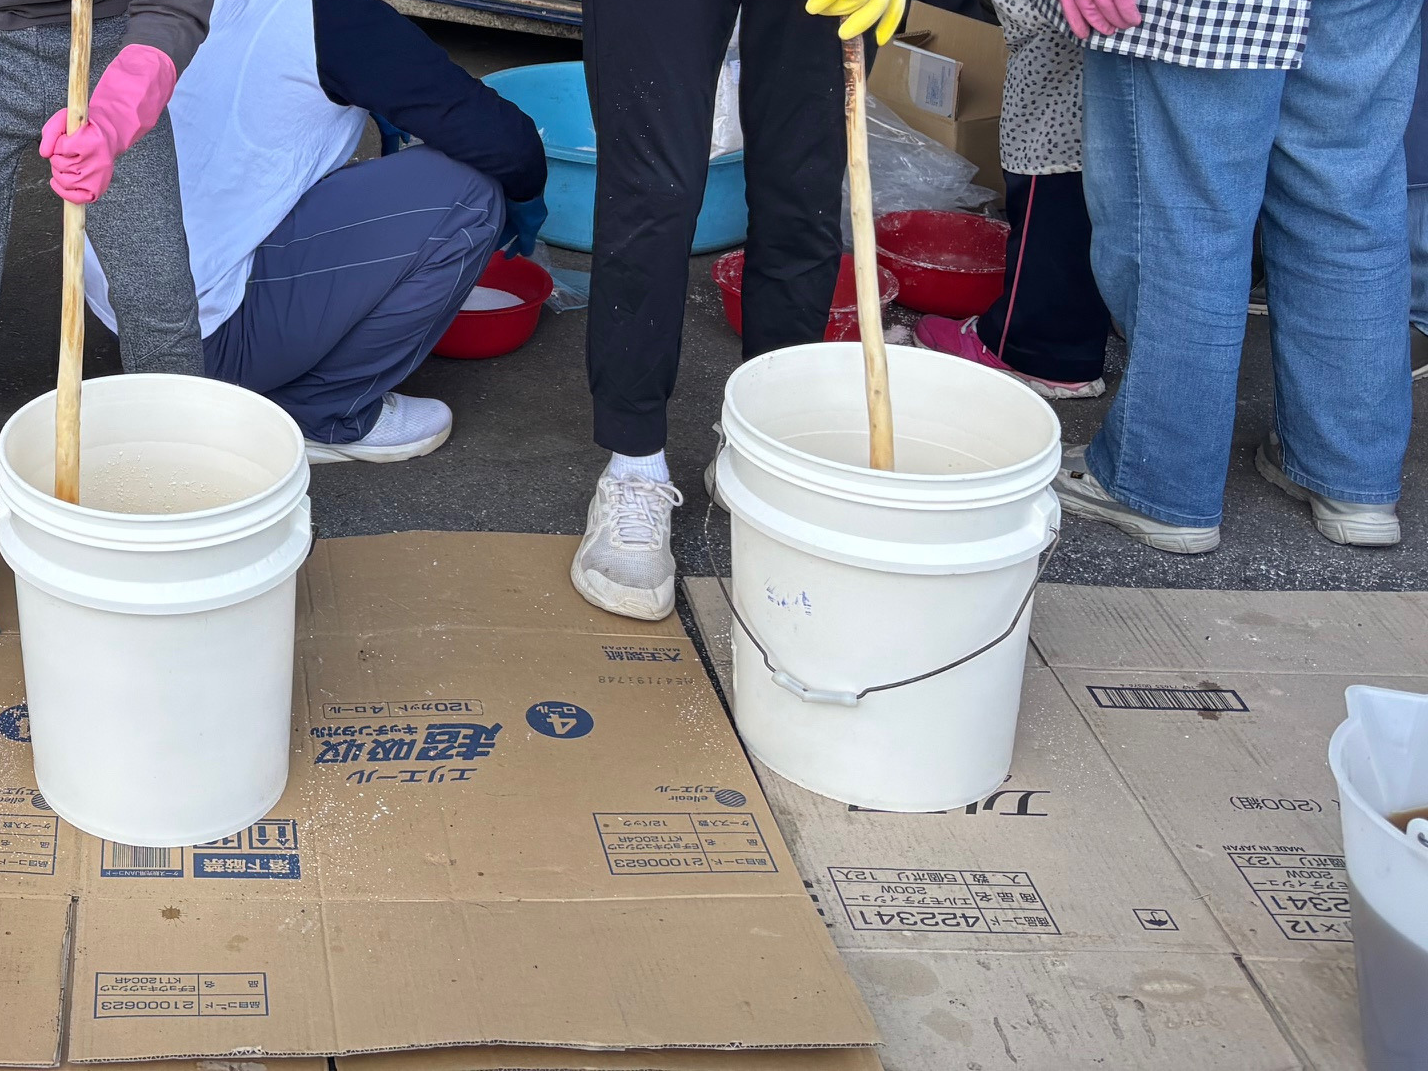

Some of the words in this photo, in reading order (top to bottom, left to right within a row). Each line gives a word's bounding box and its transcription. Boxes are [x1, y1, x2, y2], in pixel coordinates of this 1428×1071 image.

[604, 650, 683, 663] 大王製紙
[398, 701, 473, 714] 120カット
[309, 723, 418, 739] キッチンタオル
[314, 722, 503, 765] 超吸収
[345, 766, 478, 785] エリエール
[654, 785, 719, 794] エリエール
[668, 795, 708, 803] elleair
[697, 819, 750, 827] ケース入数
[617, 835, 683, 843] KT120C4R
[613, 857, 704, 868] 21000623
[1236, 855, 1281, 865] 12入
[1299, 857, 1345, 867] 個ポリ
[203, 858, 290, 874] 落下厳禁
[836, 870, 876, 880] 12入
[1285, 870, 1333, 879] 200W
[881, 885, 926, 894] 200W
[1253, 880, 1348, 890] モアティシュー
[845, 894, 972, 906] エルモアティシュー
[1270, 895, 1350, 912] 2341
[858, 910, 980, 927] 422341
[990, 915, 1051, 927] 商品コード
[114, 977, 181, 985] KT120C4R
[100, 984, 196, 993] Eチョウキュウシュウ
[101, 1000, 194, 1011] 21000623
